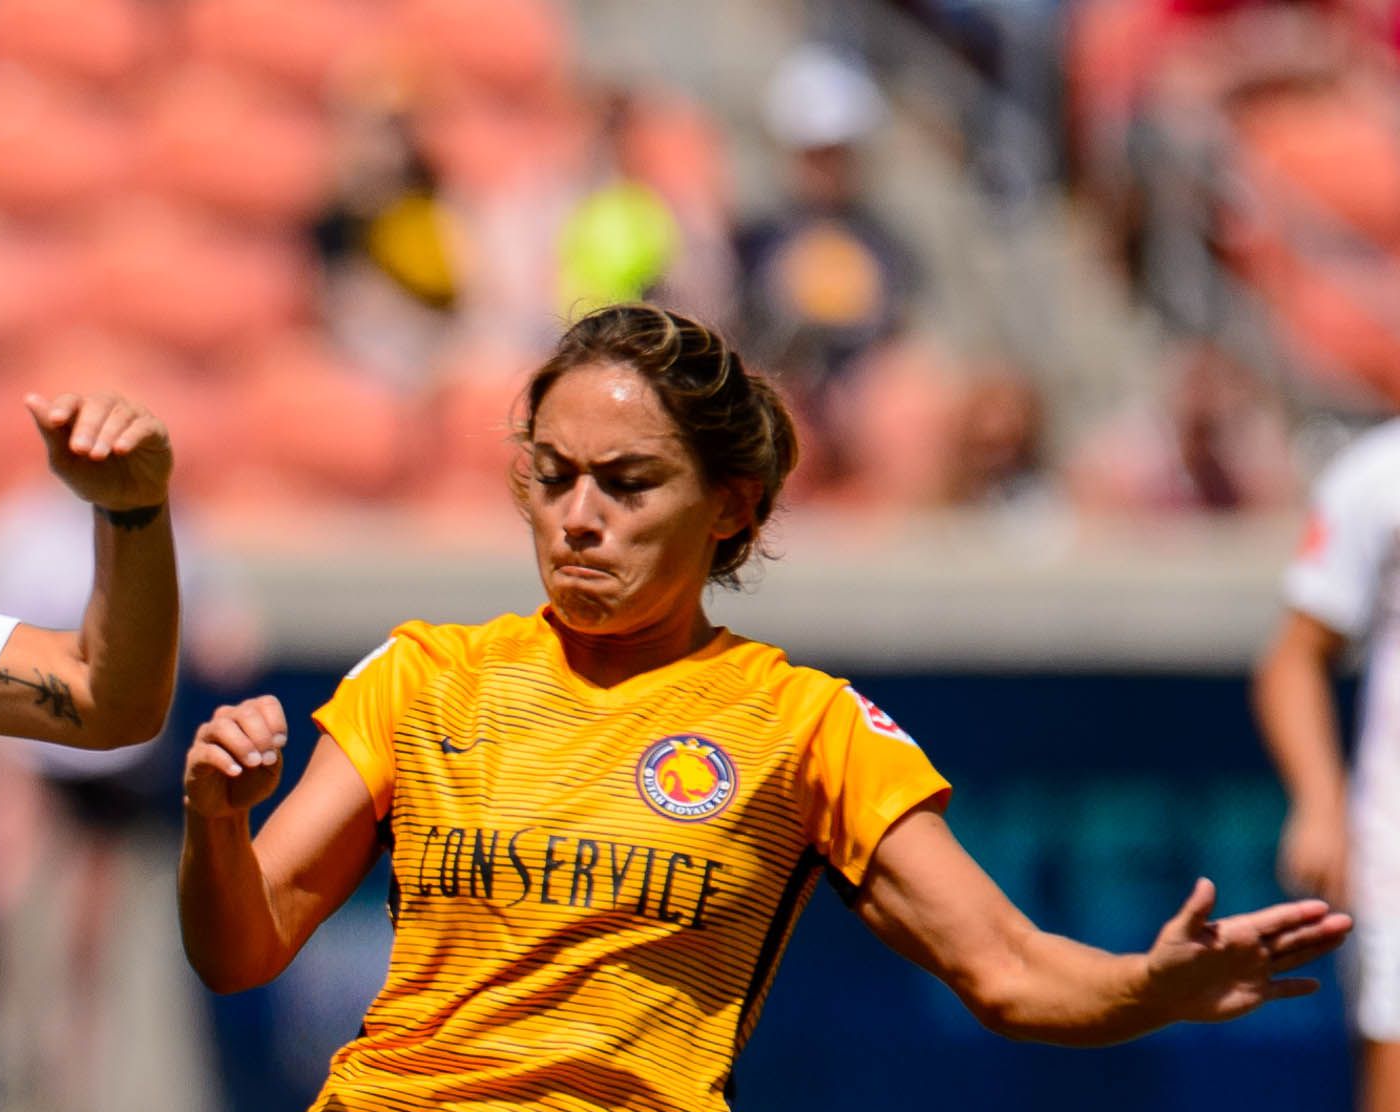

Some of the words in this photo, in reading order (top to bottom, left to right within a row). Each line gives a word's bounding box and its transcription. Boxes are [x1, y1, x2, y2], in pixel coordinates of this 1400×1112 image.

[644, 777, 668, 806] UTAH
[666, 801, 715, 815] ROYALS
[419, 825, 725, 930] CONSERVICE
